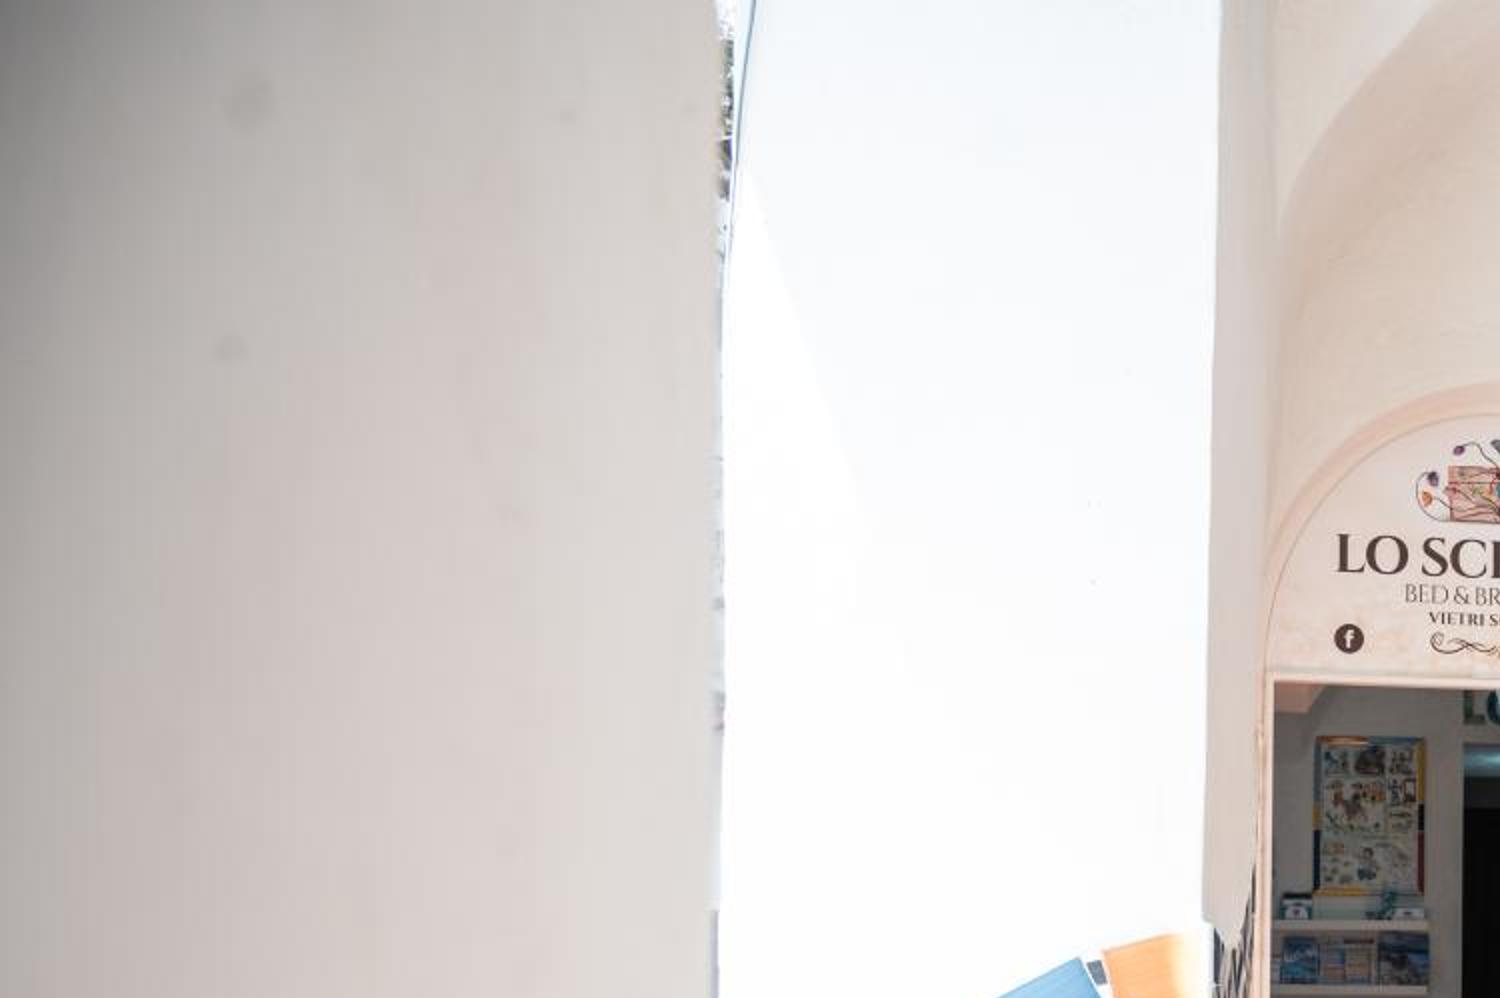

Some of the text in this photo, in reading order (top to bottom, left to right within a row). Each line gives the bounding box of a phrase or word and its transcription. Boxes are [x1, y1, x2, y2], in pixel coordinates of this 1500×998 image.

[1336, 533, 1409, 576] LO
[1405, 583, 1448, 605] BED
[1454, 586, 1470, 606] &
[1429, 611, 1485, 629] VIETRI
